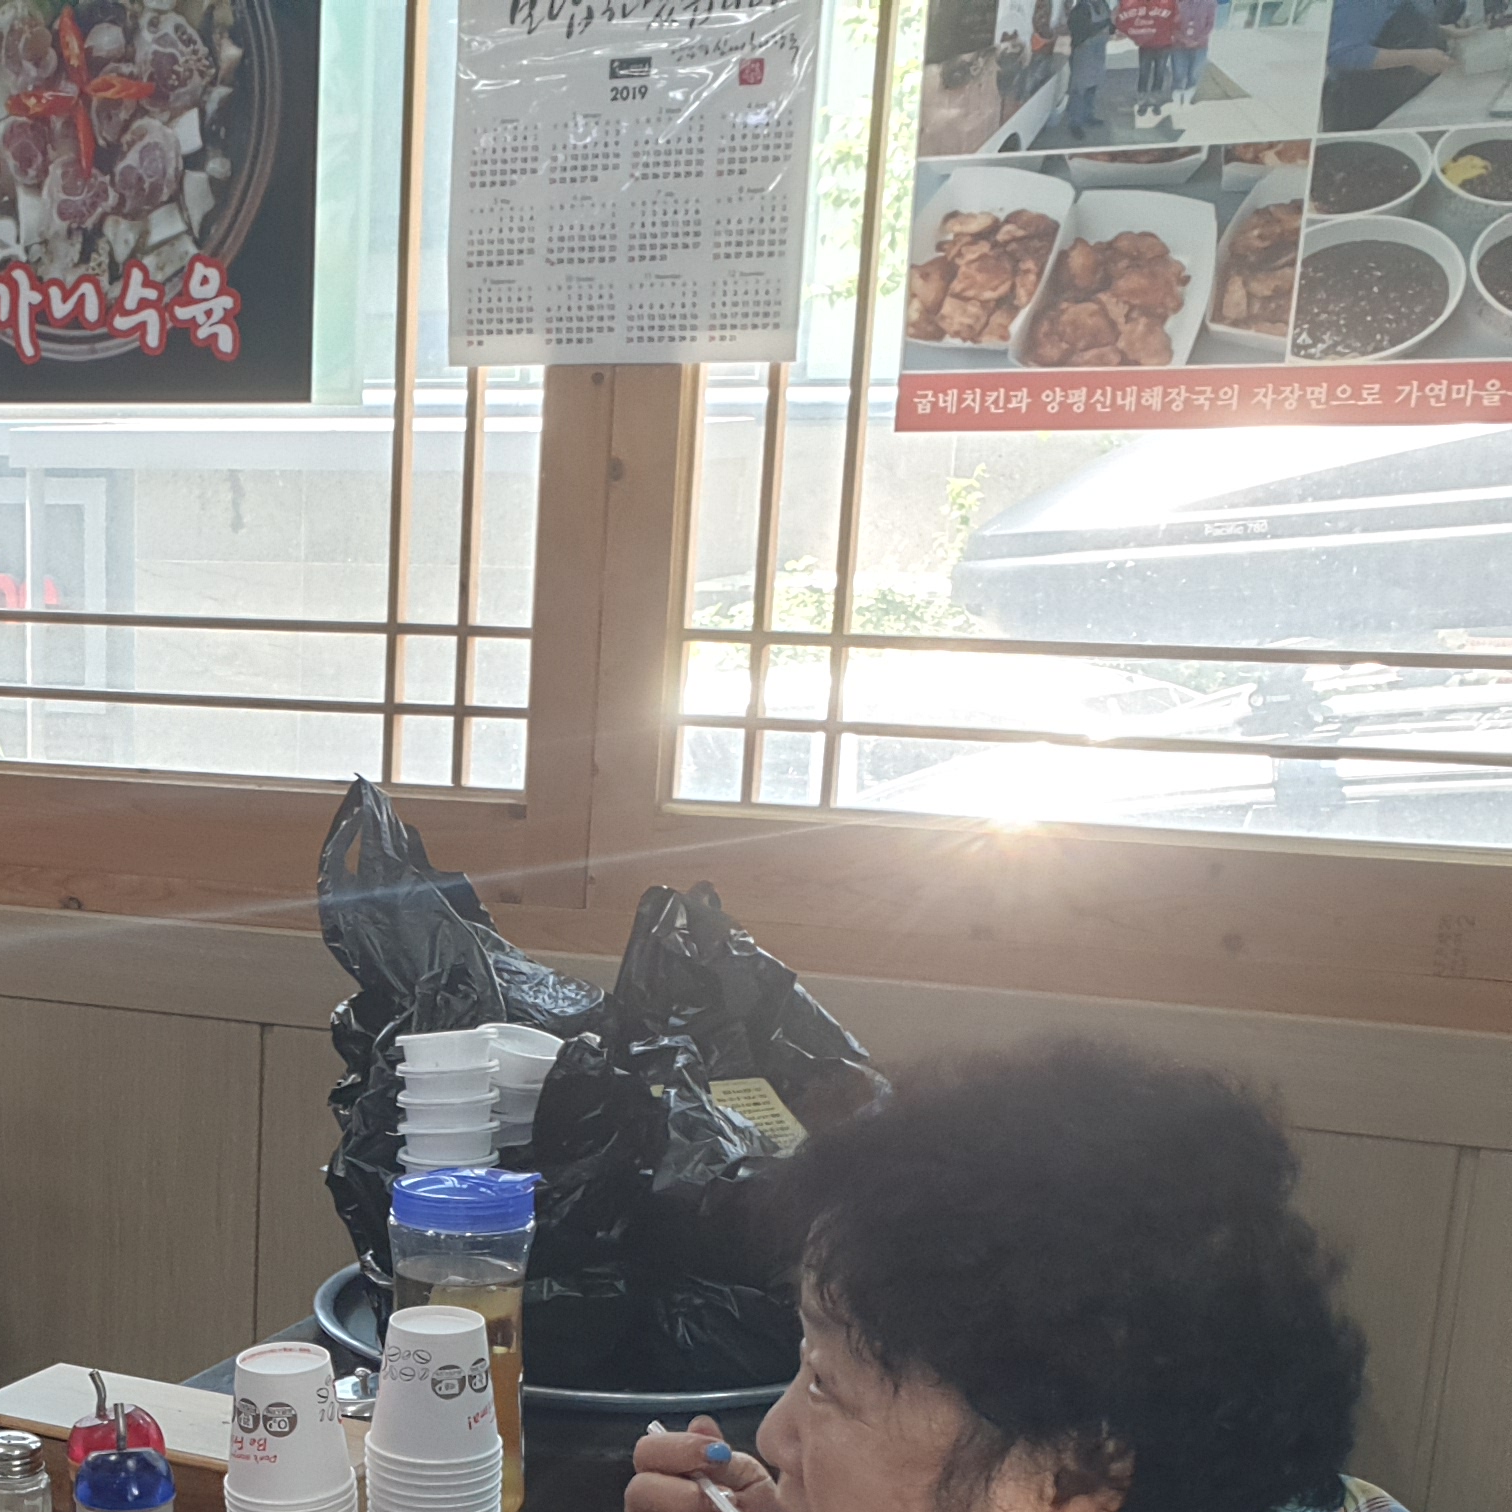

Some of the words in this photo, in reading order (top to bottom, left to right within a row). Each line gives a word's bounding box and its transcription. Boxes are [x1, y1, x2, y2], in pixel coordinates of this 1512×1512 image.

[610, 86, 648, 101] 2019
[913, 388, 1031, 415] 굽네치킨과
[1040, 384, 1241, 414] 양평신내해장국의
[1251, 381, 1383, 409] 자장면으로
[1394, 378, 1512, 408] 가연마을
